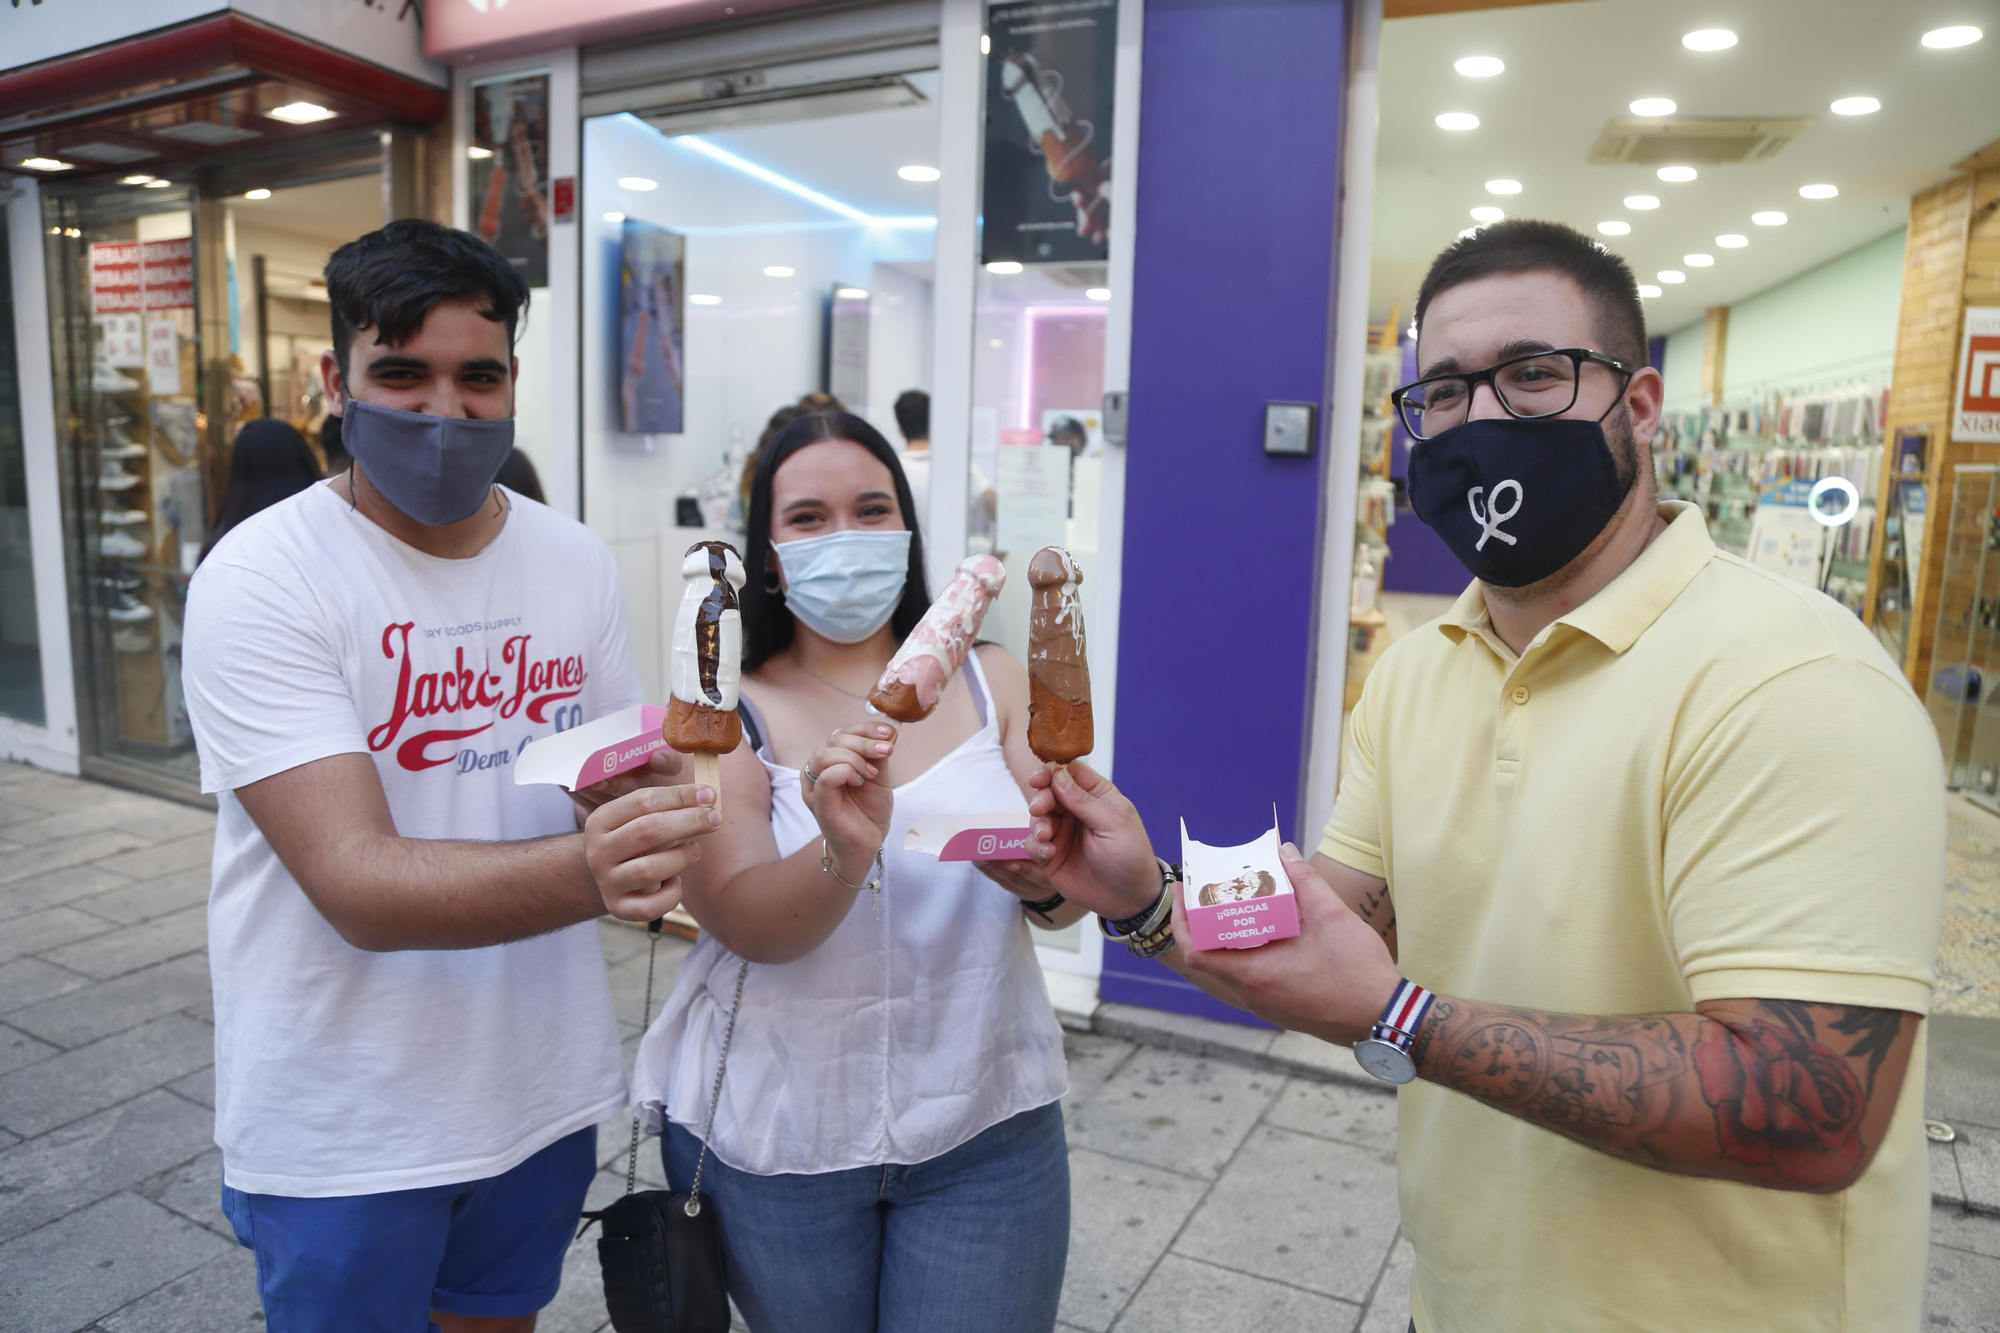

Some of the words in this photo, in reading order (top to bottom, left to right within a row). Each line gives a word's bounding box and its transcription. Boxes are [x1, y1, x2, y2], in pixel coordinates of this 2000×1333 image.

[423, 627, 441, 638] RY
[1217, 903, 1268, 920] ¡¡GRACIAS
[1233, 917, 1256, 927] POR
[1218, 925, 1276, 941] COMERLA!!
